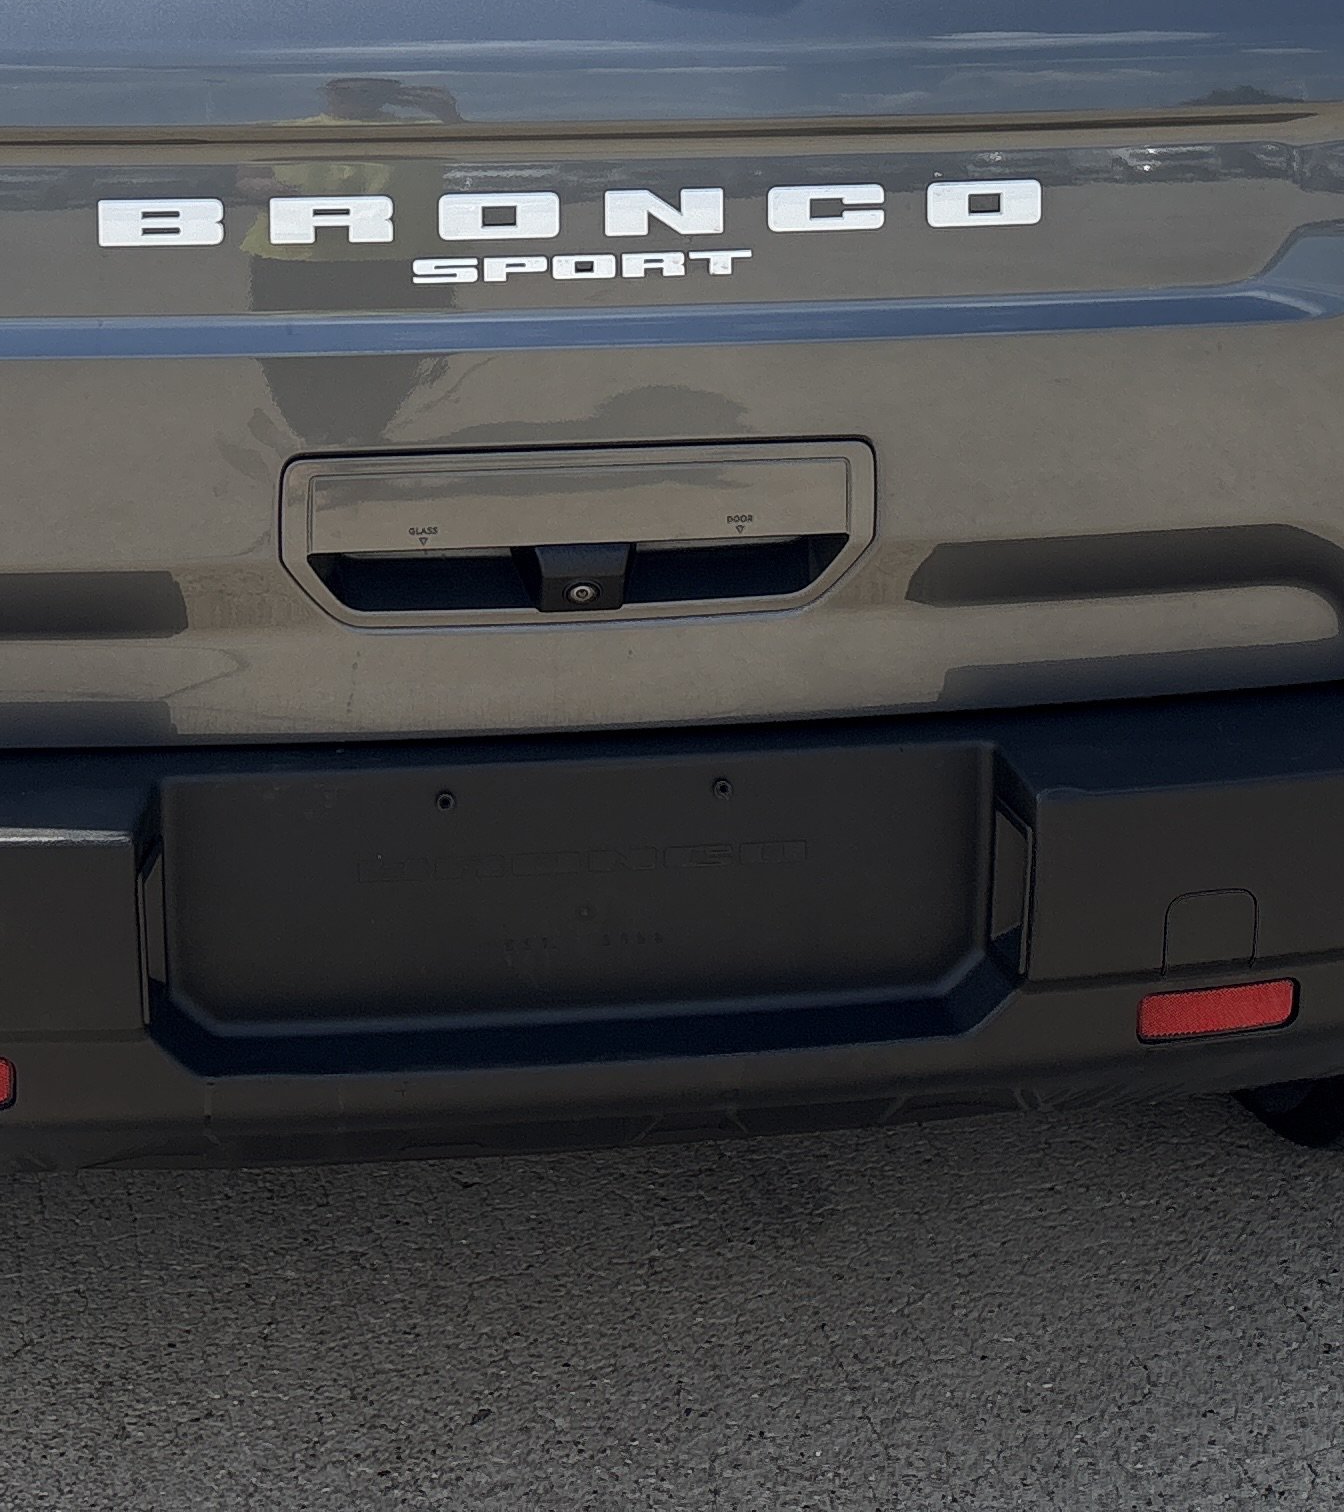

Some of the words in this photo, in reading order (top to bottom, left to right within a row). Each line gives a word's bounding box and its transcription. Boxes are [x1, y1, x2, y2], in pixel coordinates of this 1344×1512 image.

[97, 178, 1044, 248] BRONCO
[411, 248, 753, 285] SPORT
[408, 525, 438, 536] GLASS
[726, 513, 754, 524] DOOR
